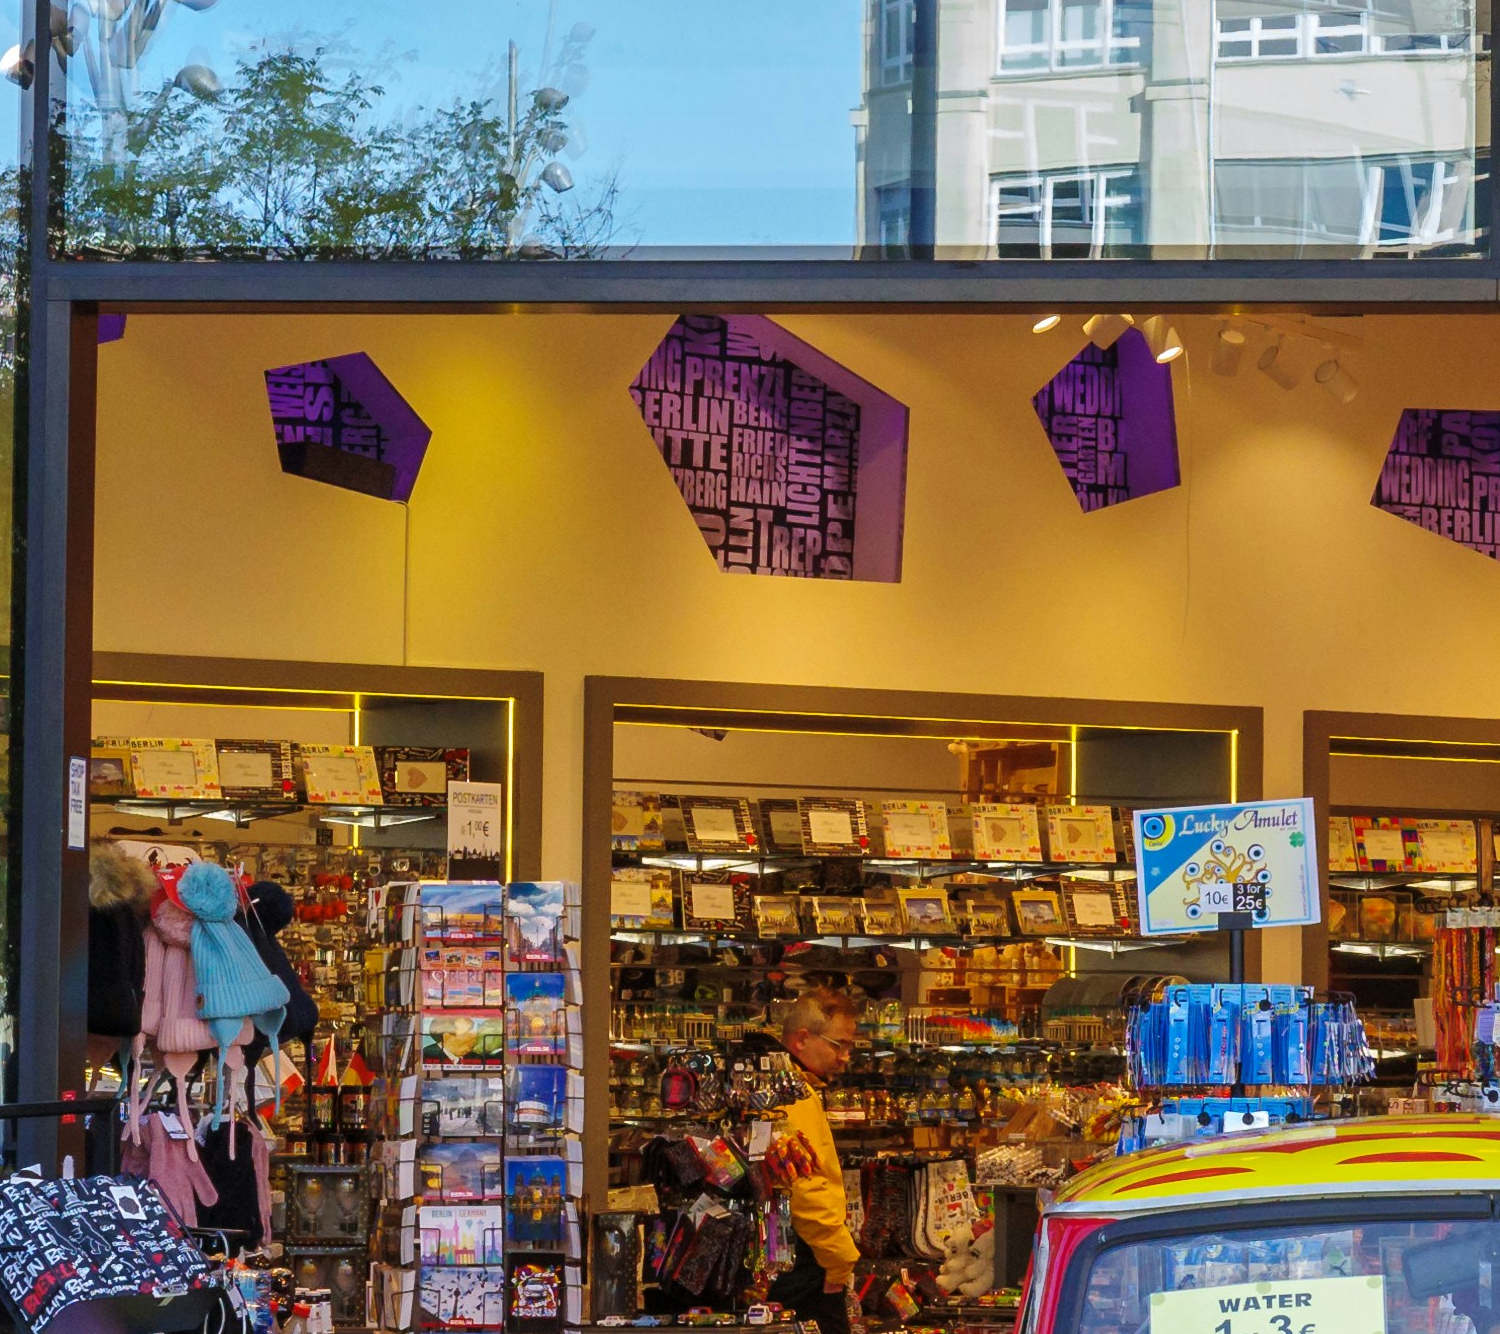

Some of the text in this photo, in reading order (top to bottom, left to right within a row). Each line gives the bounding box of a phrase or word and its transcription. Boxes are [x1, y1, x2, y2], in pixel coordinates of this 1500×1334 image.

[685, 356, 788, 409] PRENZL
[734, 400, 787, 430] BERG
[733, 427, 788, 457] FRIED
[732, 452, 786, 483] RICHS
[1381, 453, 1470, 508] WEDDING
[730, 477, 786, 507] HAIN
[131, 740, 164, 749] BERLIN
[301, 746, 329, 754] BERLIN
[70, 763, 85, 777] SHOP
[70, 781, 81, 797] TAX
[452, 792, 498, 806] POSTKARTEN
[70, 799, 83, 814] FREE
[883, 802, 909, 811] BERLIN
[973, 804, 998, 813] BERLIN
[1048, 806, 1073, 815] BERLIN
[1179, 808, 1297, 838] Lucky Amulet
[1237, 883, 1261, 894] 3 for
[1205, 891, 1228, 905] 10€
[1236, 896, 1263, 910] 25€
[431, 1209, 487, 1218] BERLIN GERMANY
[1219, 1293, 1312, 1313] WATER
